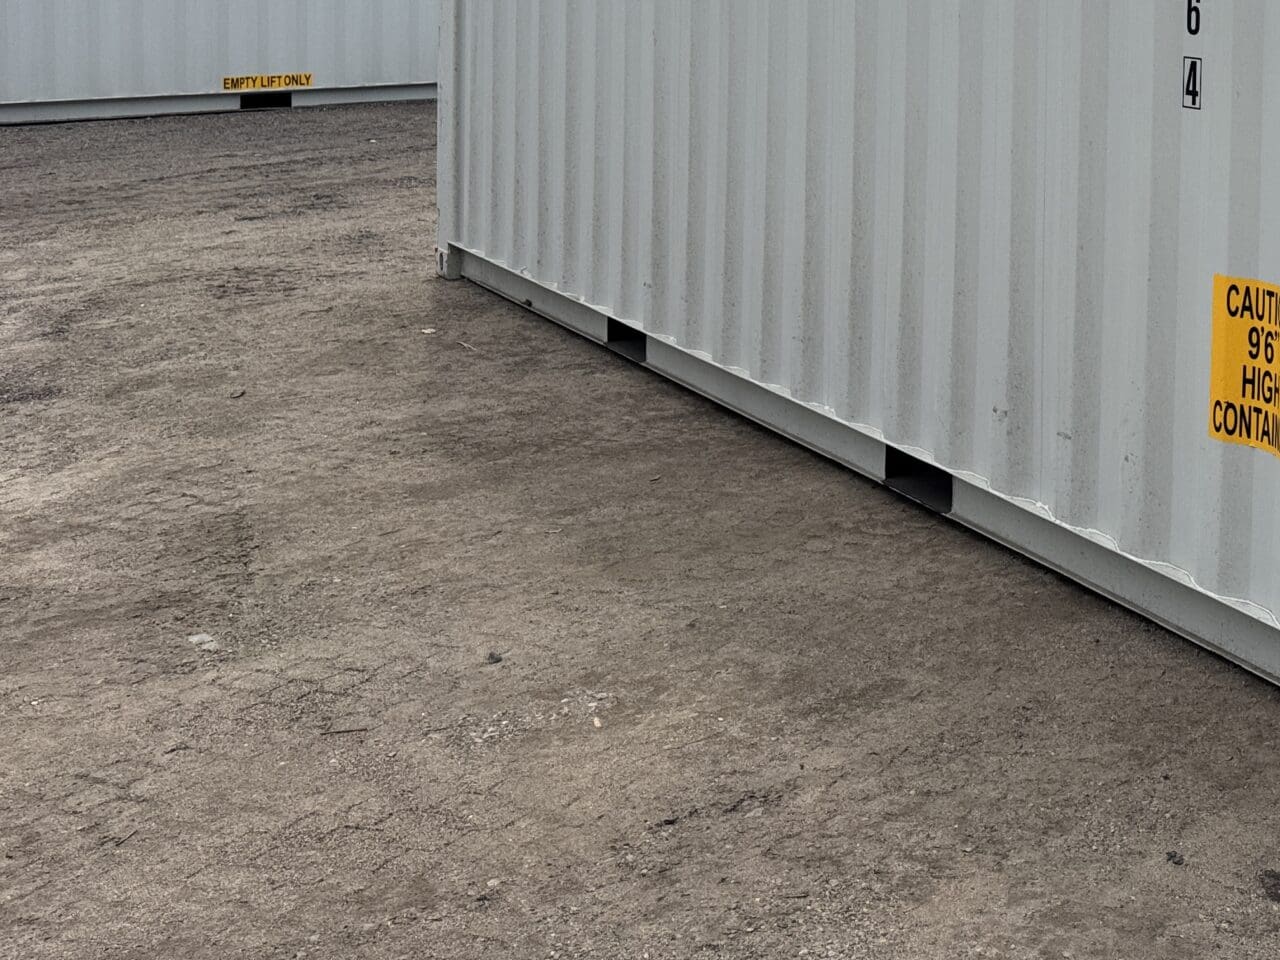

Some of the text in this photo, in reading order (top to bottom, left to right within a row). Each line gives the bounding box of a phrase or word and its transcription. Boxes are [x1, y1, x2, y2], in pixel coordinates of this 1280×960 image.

[223, 74, 312, 90] EMPTY LIFT ONLY
[1184, 59, 1200, 108] 4
[1241, 364, 1280, 409] HIGH
